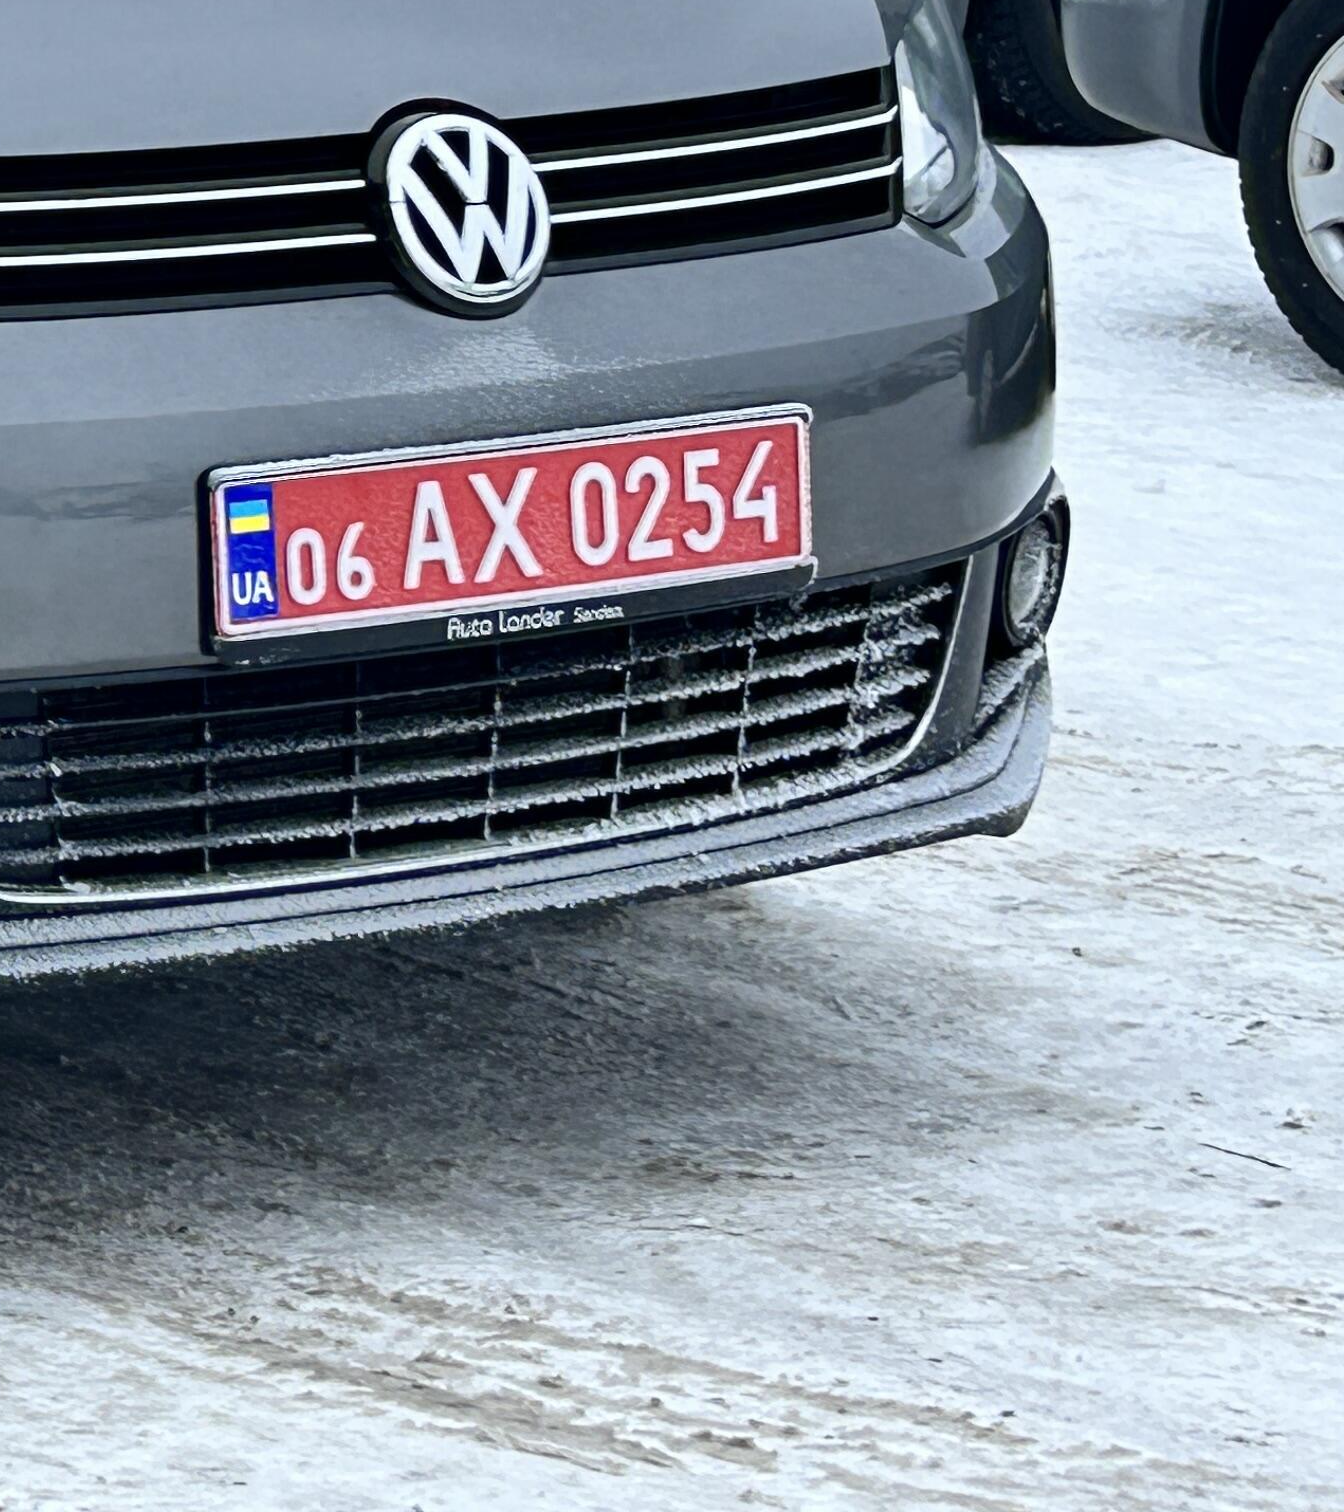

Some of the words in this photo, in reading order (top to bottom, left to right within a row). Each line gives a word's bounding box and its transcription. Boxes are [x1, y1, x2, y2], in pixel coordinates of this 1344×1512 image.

[286, 521, 376, 606] 06
[404, 466, 544, 591] AX
[569, 439, 778, 568] 0254
[232, 570, 275, 606] UA
[447, 617, 494, 641] Auto
